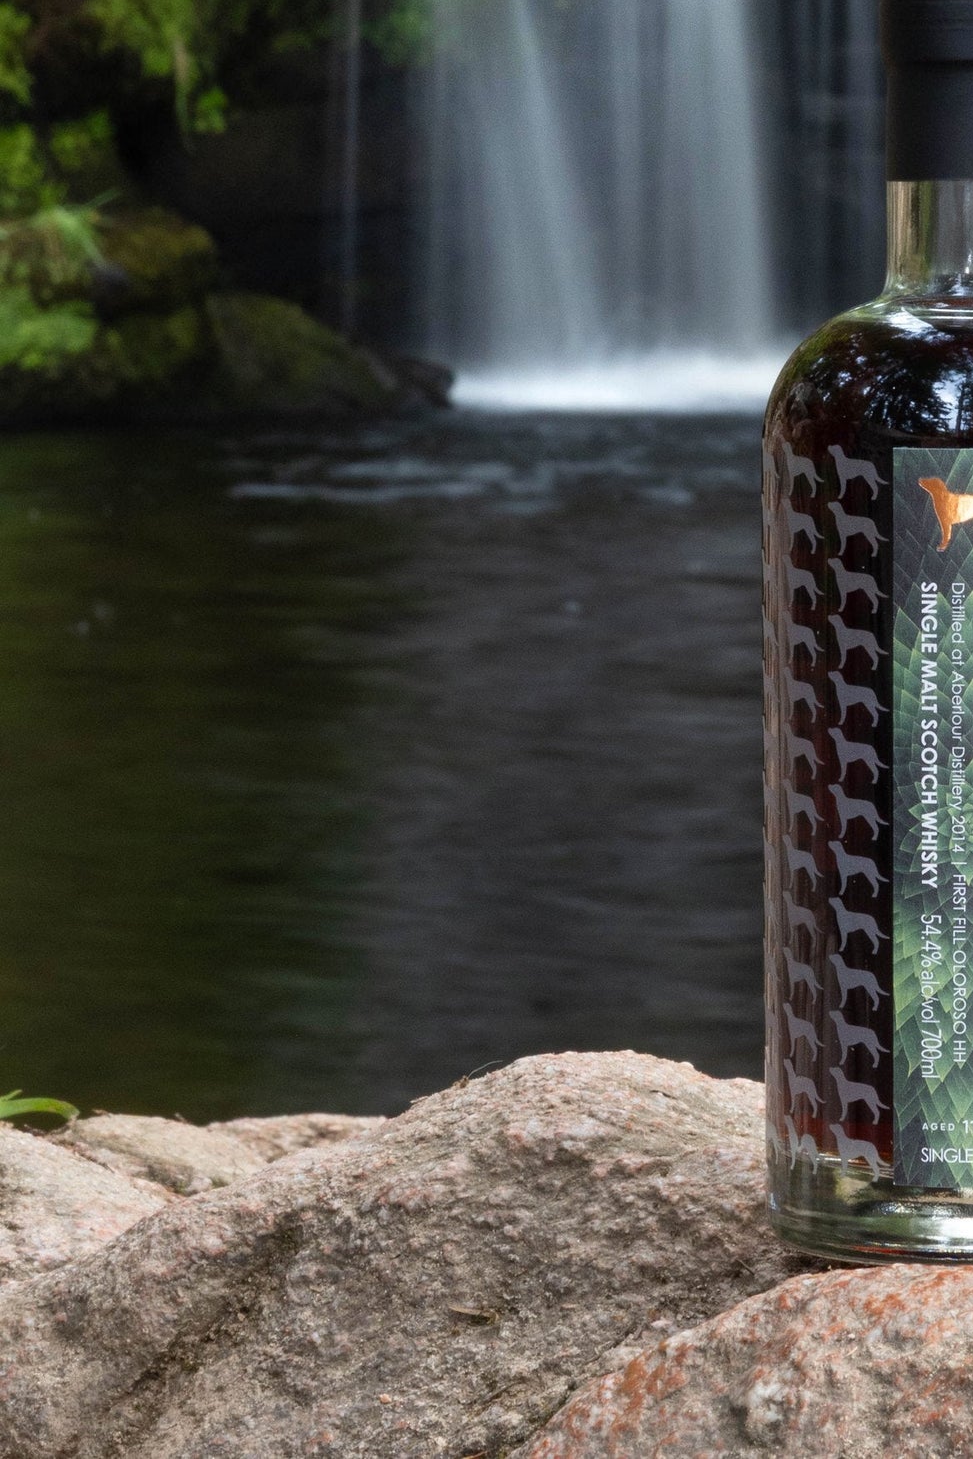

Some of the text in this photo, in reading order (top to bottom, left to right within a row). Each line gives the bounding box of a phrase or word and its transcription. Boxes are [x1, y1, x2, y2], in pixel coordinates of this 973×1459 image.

[920, 581, 943, 1079] SINGLE MALT SCOTCH WHISKY 54.4% alc/vol 700ml
[948, 583, 967, 1062] Distilled at Aberlour Distillery 2014 FIRST FILL OLOROSO HH
[920, 1147, 973, 1164] SINGLE
[922, 1122, 955, 1132] AGED
